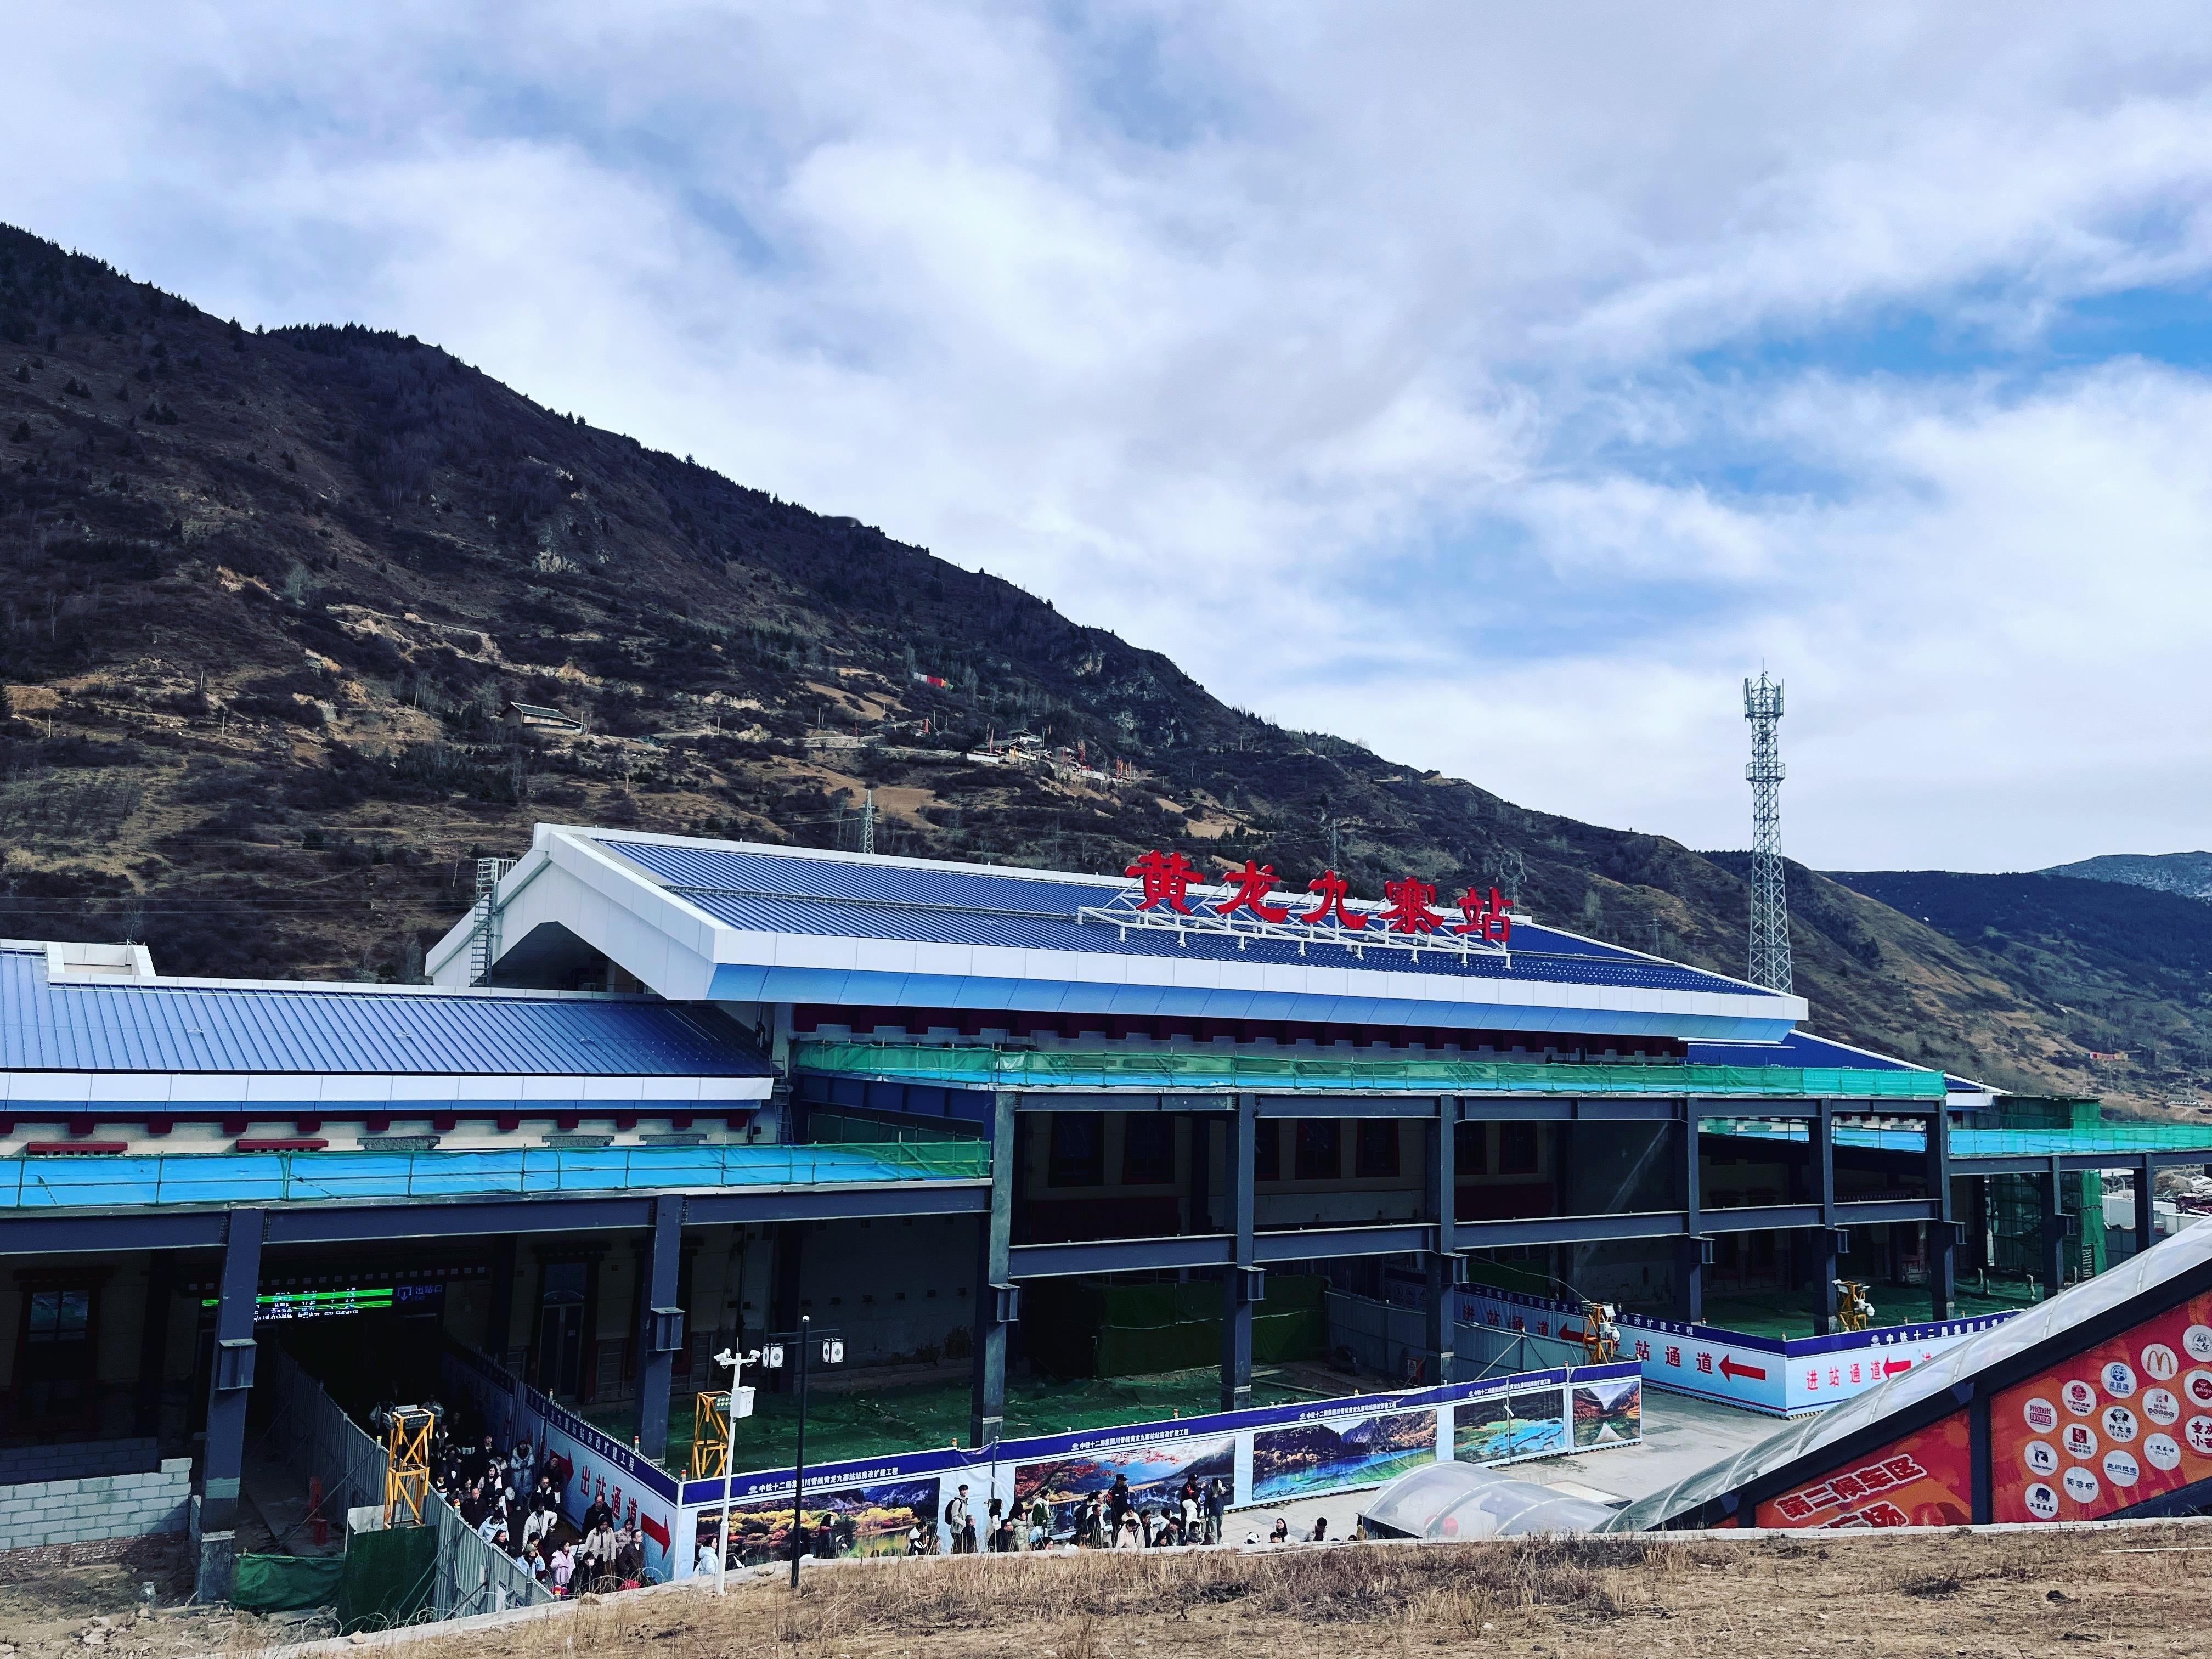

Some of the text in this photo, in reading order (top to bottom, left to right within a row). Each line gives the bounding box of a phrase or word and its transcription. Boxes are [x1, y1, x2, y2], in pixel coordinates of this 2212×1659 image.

[1125, 850, 1513, 941] 黄龙九寨站
[1807, 1359, 1881, 1390] 进站通道
[1775, 1454, 1926, 1520] 第二候车区
